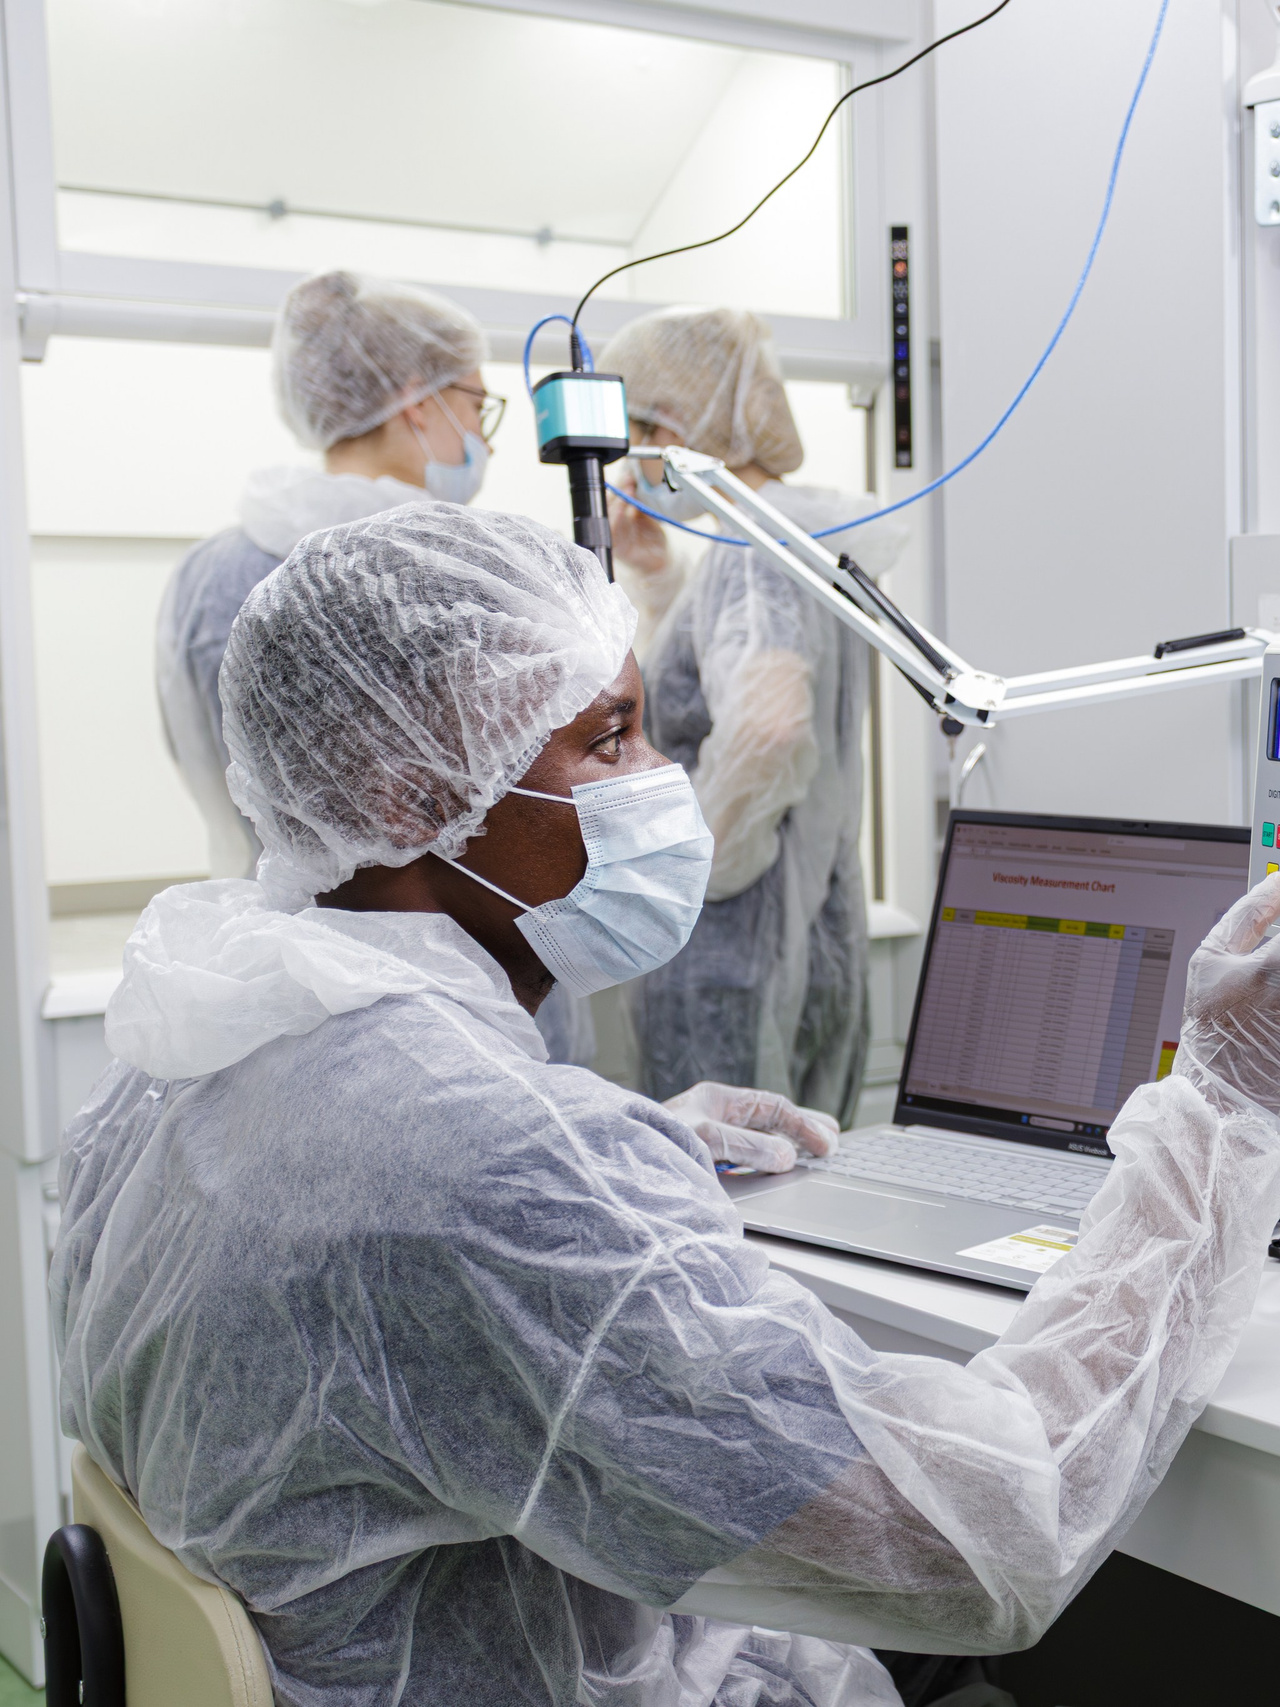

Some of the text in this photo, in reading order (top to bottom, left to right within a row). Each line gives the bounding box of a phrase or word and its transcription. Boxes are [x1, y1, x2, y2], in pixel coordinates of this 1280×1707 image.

[992, 872, 1116, 893] Viscosity Measurement Chart
